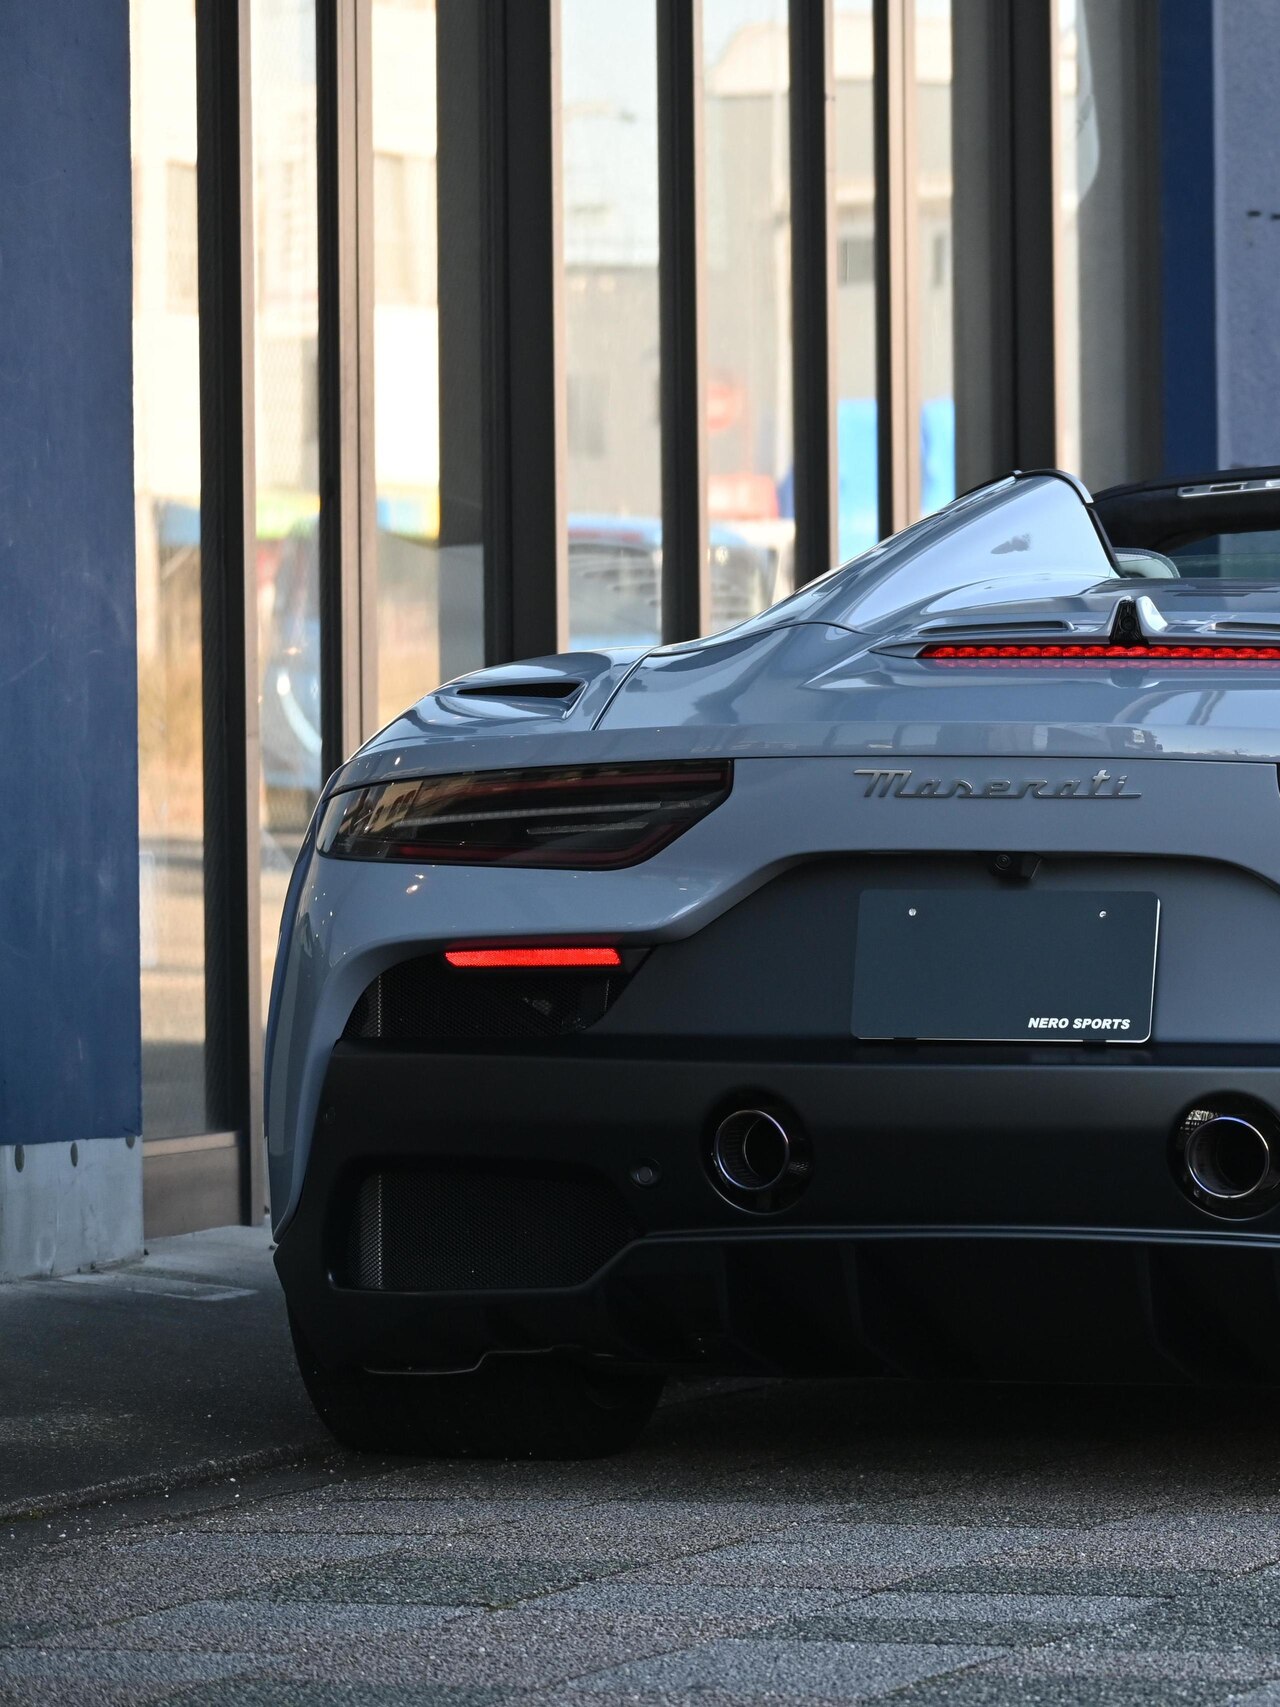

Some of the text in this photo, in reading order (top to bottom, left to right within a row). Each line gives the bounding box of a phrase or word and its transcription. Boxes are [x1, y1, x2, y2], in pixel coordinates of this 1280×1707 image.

[854, 768, 1142, 799] Maserati
[1027, 1017, 1131, 1030] NERO SPORTS
